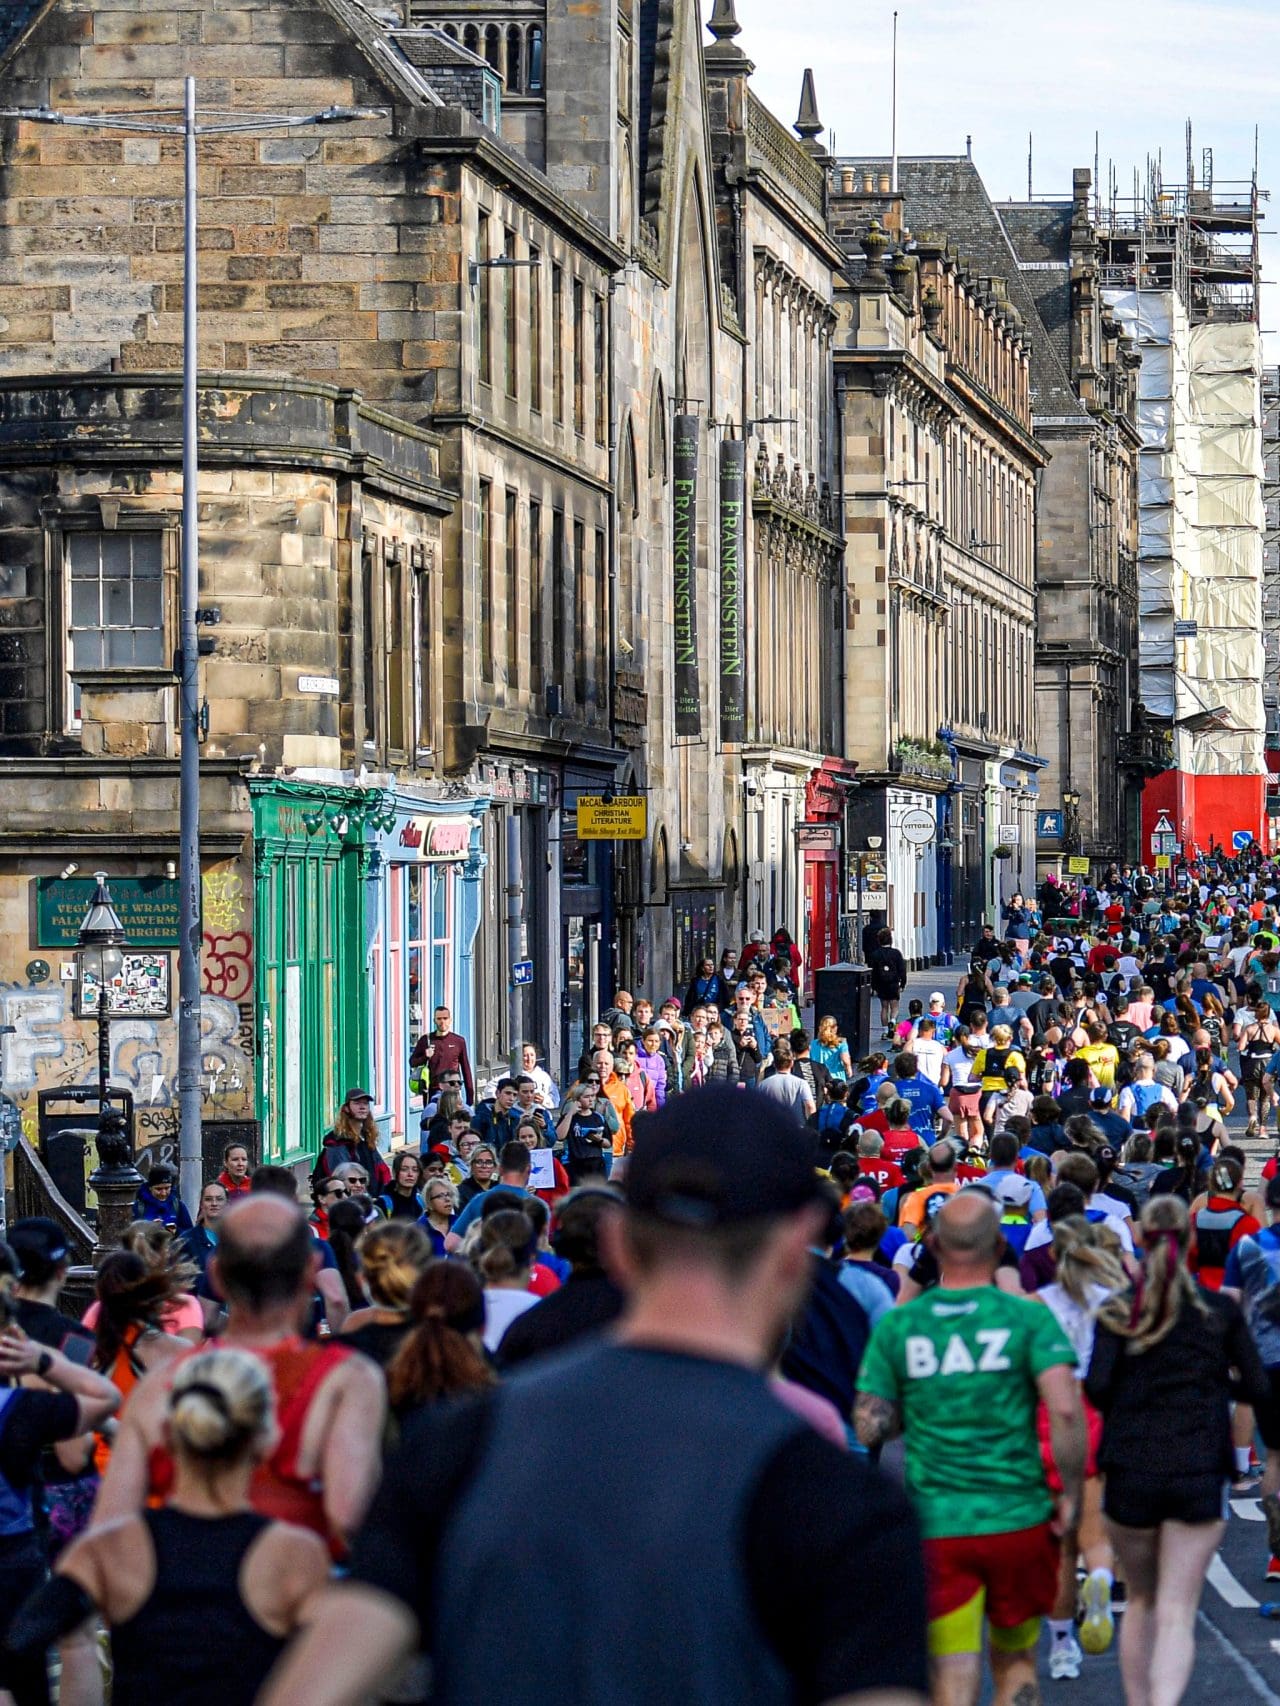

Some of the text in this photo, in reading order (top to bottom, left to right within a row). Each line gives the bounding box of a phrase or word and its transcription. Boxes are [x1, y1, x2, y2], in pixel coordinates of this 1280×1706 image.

[675, 480, 696, 665] FRANKENSTEIN
[721, 501, 742, 676] FRANKENSTEIN
[580, 798, 609, 807] McCAL
[57, 903, 128, 913] VEGELE
[119, 916, 181, 925] HAWERM
[127, 929, 177, 937] URGERS
[905, 1328, 1012, 1379] BAZ
